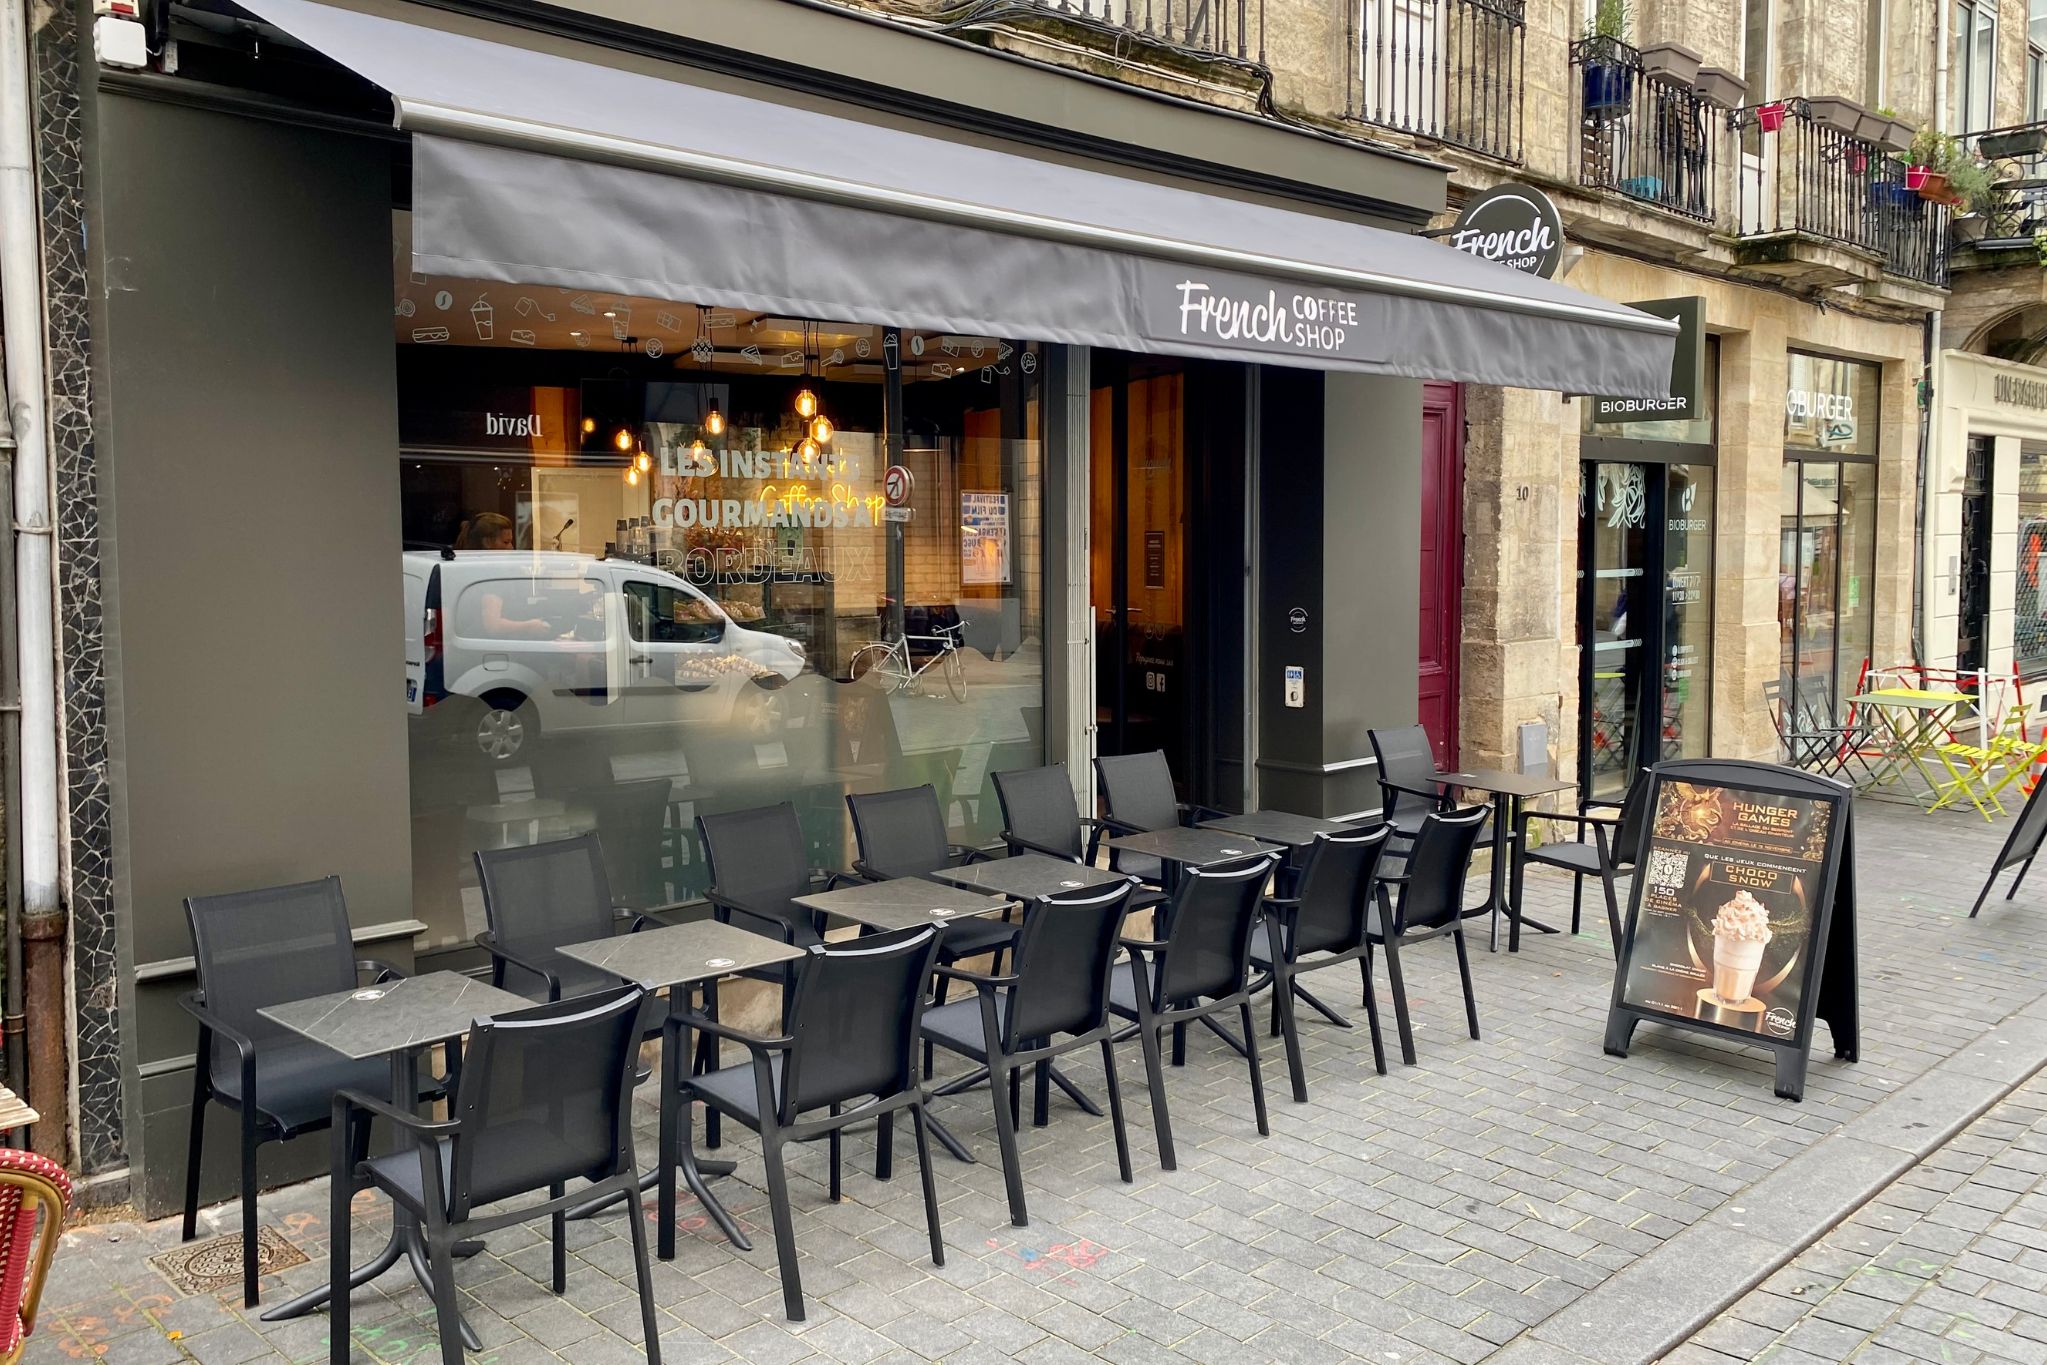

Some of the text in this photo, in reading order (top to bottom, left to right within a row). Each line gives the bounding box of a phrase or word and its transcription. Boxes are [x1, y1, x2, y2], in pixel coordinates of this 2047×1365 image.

[1452, 216, 1555, 260] French
[1176, 280, 1293, 343] French
[1292, 294, 1359, 326] COFFEE
[1295, 322, 1345, 351] SHOP
[1601, 396, 1687, 413] BIOBURGER
[660, 447, 715, 478] LES
[720, 449, 861, 481] INSTANTS
[1516, 485, 1529, 501] 10
[652, 498, 850, 528] GOURMANDS
[1668, 519, 1707, 531] BIOBURGER
[656, 547, 873, 587] BORDEAUX
[1733, 802, 1798, 819] HUNGER
[1738, 813, 1791, 827] GAMES
[1704, 853, 1719, 861] QUE
[1736, 858, 1755, 866] JEUX
[1756, 861, 1807, 874] COMMENCENT
[1725, 865, 1778, 880] CHOCO
[1728, 874, 1773, 888] SNOW
[1653, 886, 1675, 897] 150
[1765, 1011, 1797, 1029] French
